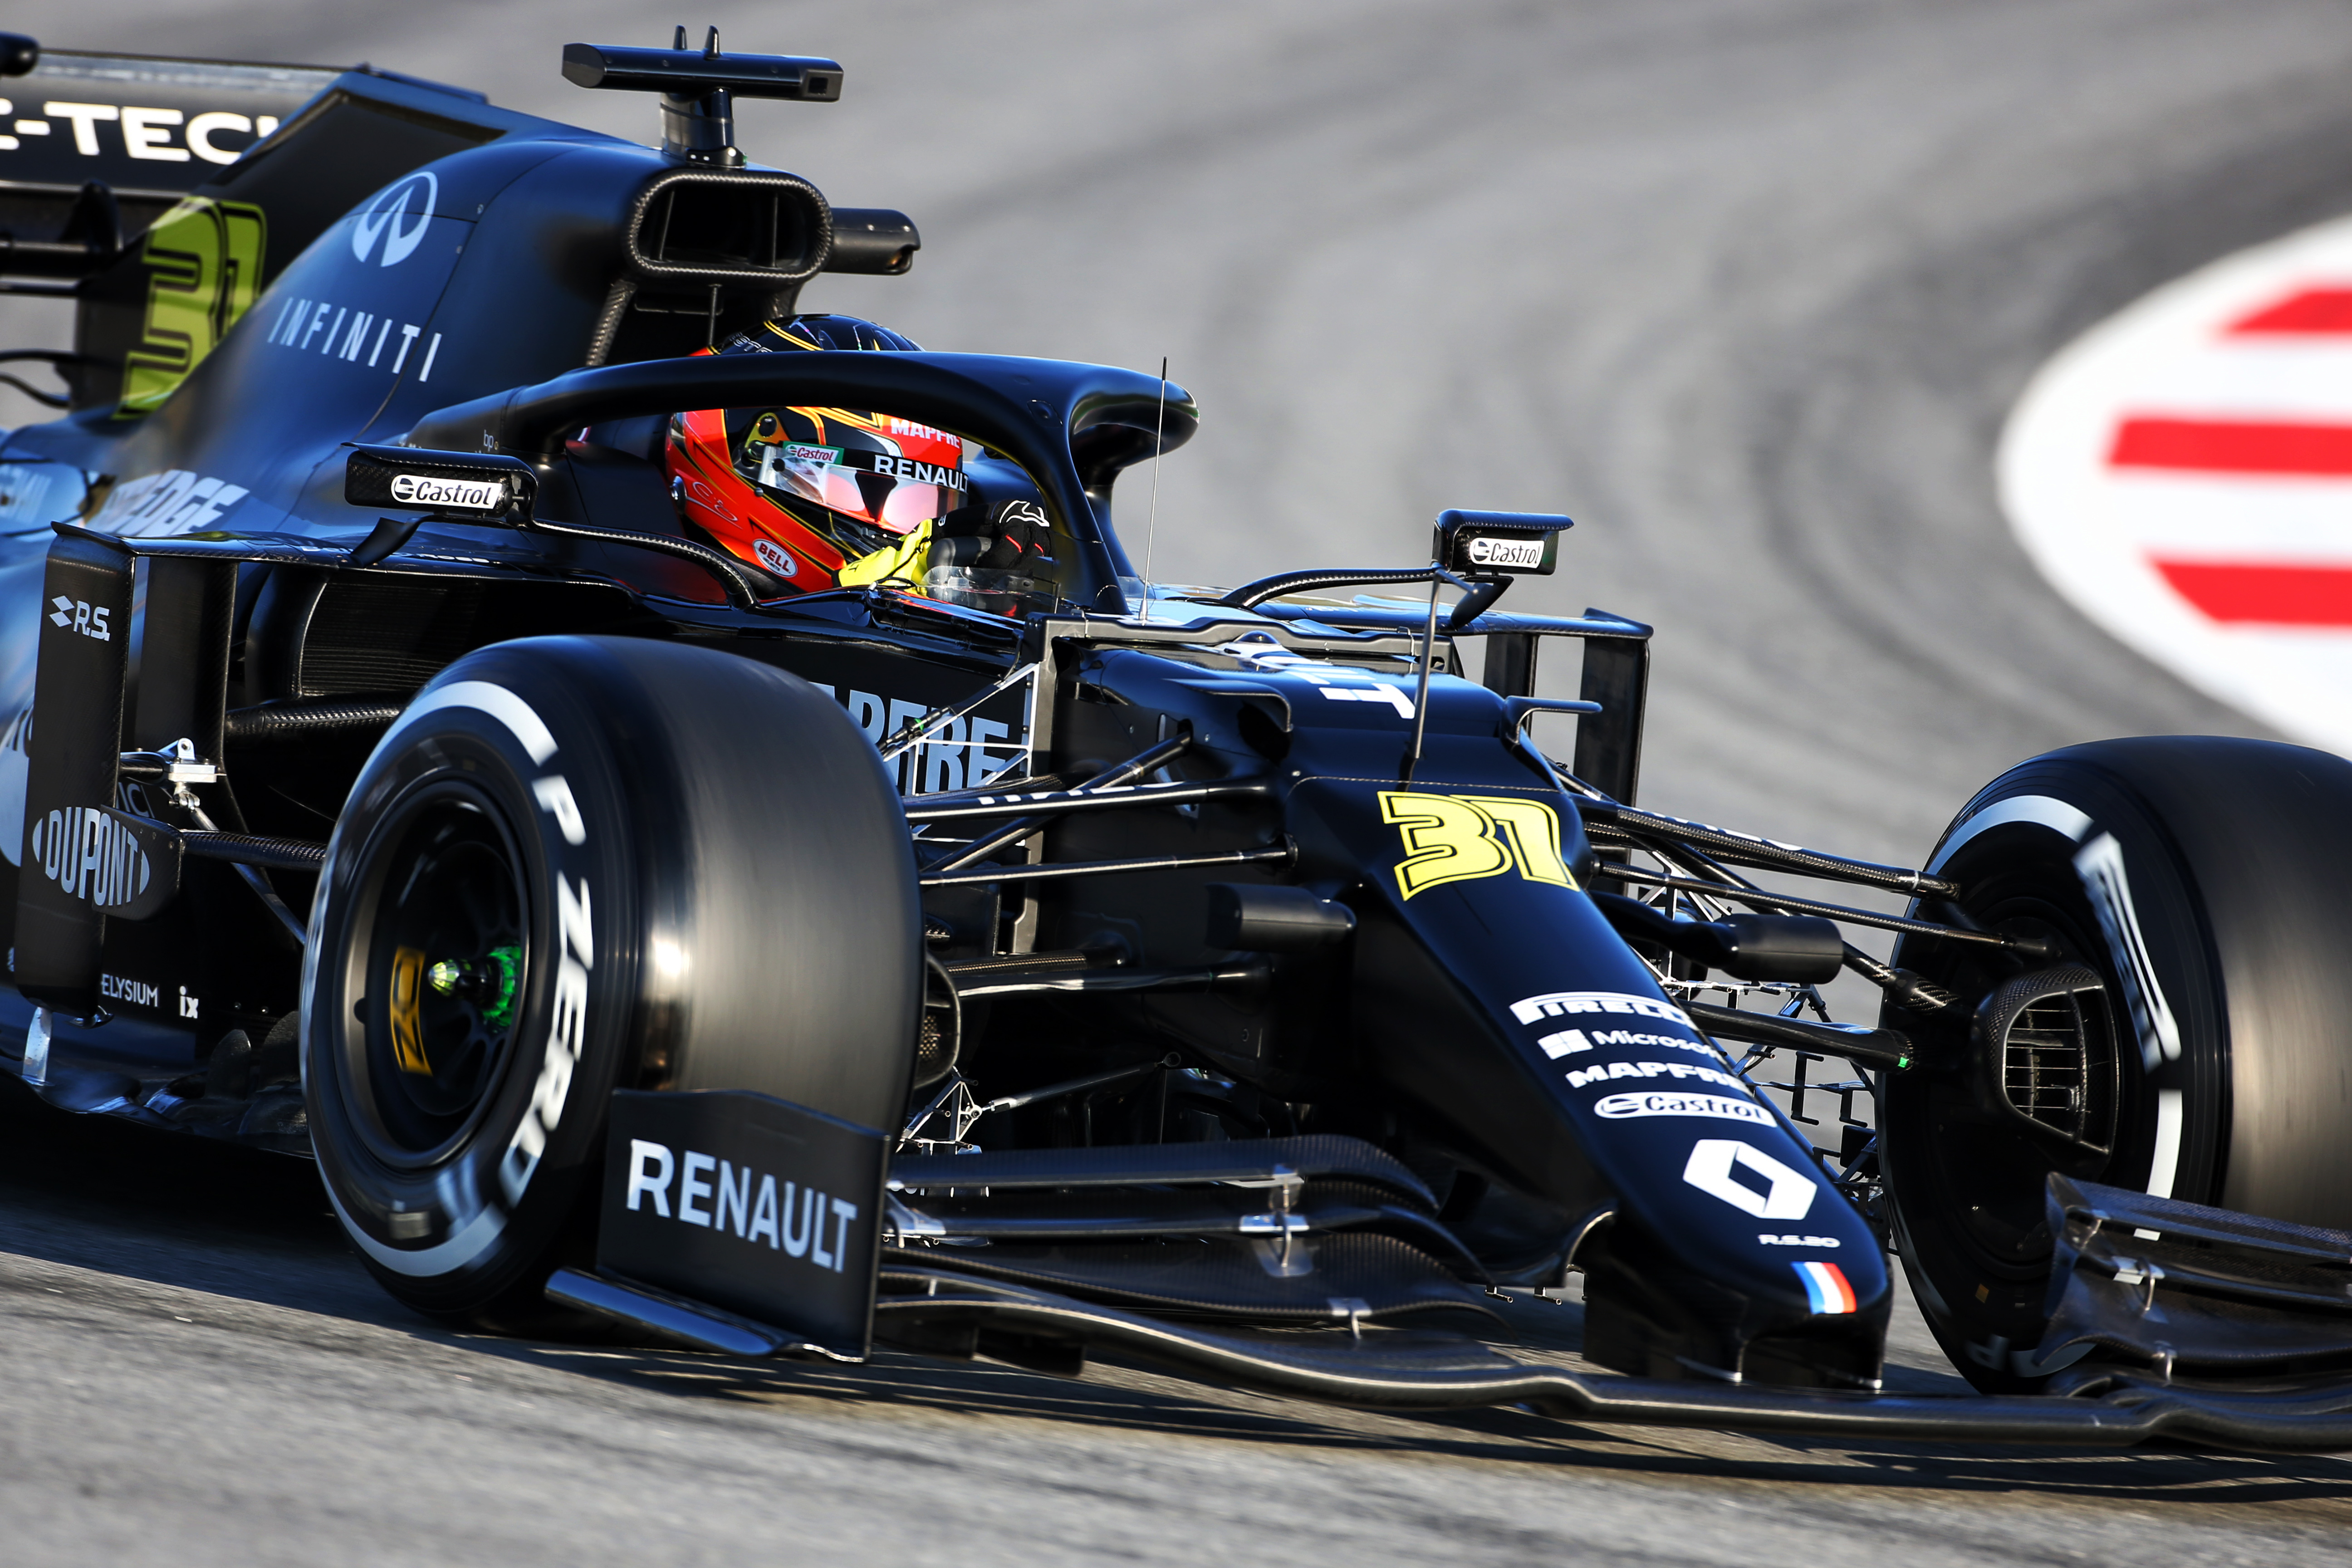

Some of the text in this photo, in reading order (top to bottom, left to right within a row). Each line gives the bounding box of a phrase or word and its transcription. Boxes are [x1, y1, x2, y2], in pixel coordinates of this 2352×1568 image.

[0, 98, 279, 165] -TEC
[267, 297, 441, 382] INFINITI
[796, 446, 834, 462] Castrol
[875, 455, 969, 493] RENAULT
[416, 481, 492, 505] Castrol
[759, 542, 789, 573] BELL
[1490, 543, 1540, 564] Castrol
[1377, 791, 1580, 901] 31
[101, 973, 158, 1007] ELYSIUM
[1644, 1095, 1768, 1121] Castrol
[627, 1138, 857, 1273] RENAULT
